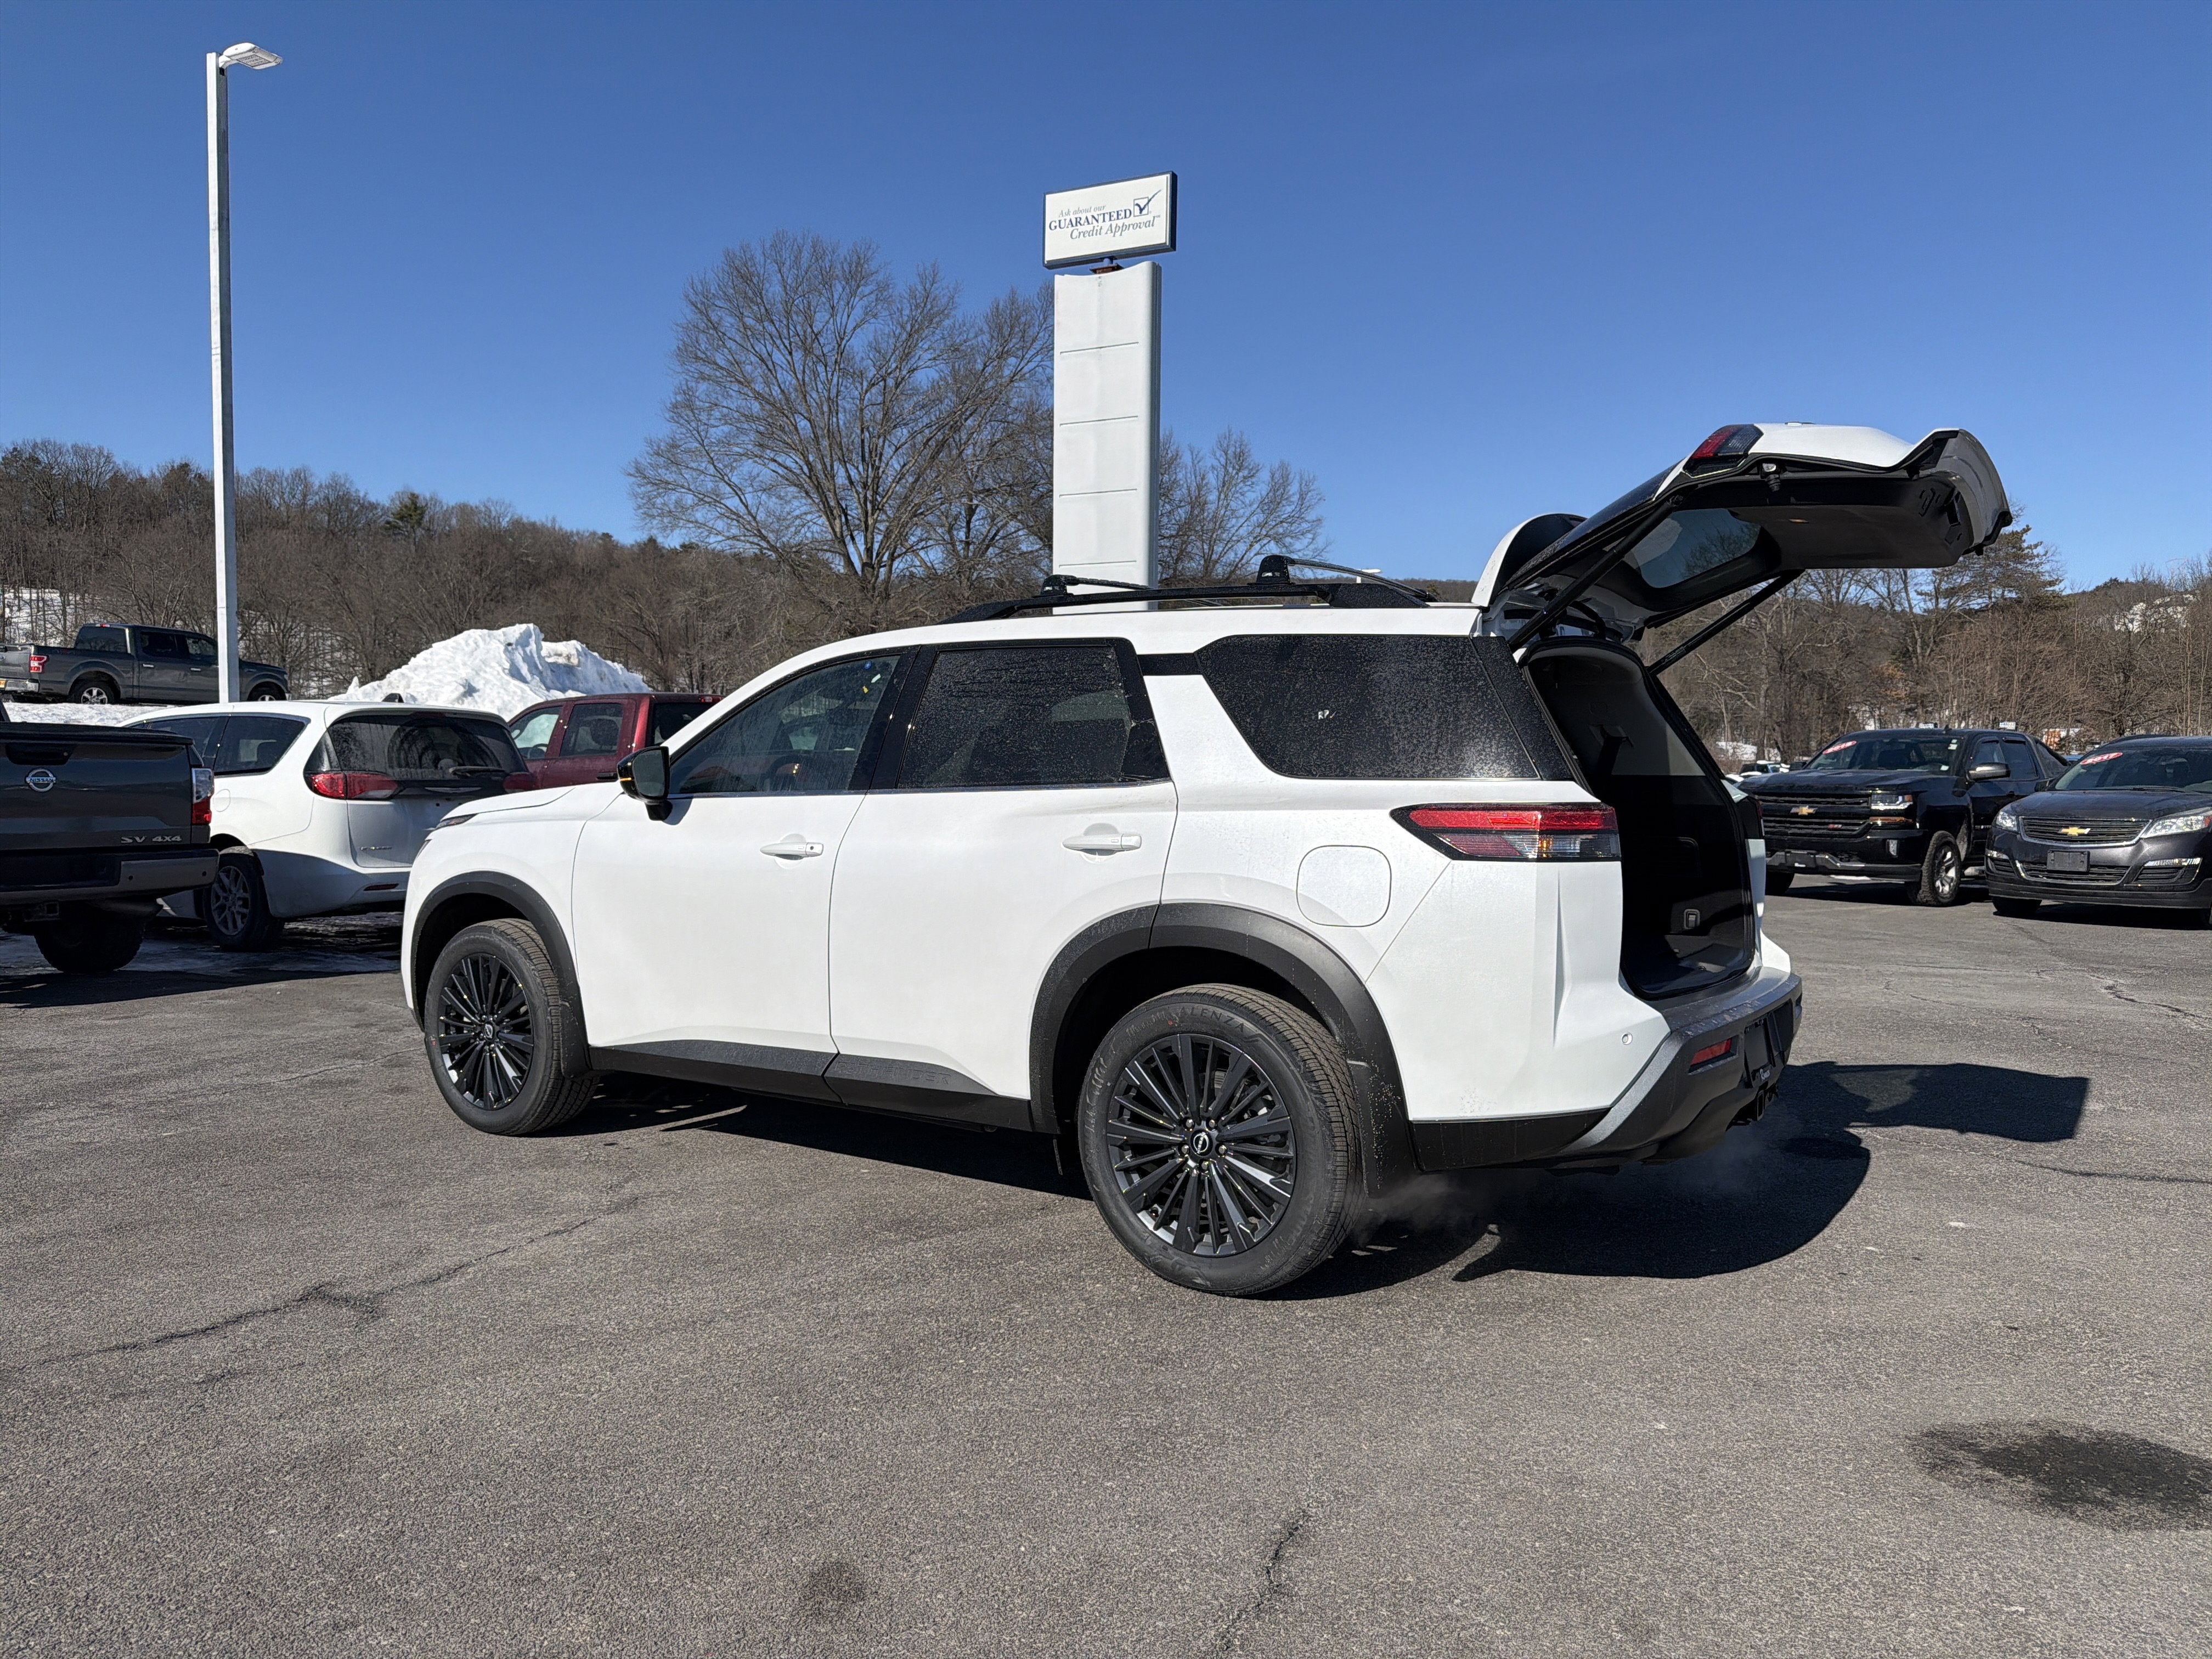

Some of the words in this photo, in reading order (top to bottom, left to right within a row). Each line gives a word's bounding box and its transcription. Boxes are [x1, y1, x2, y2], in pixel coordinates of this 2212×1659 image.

[1048, 208, 1132, 231] GUARANTEED
[1058, 208, 1071, 218] Ask
[1073, 206, 1092, 215] about
[1070, 224, 1103, 240] Credit
[1105, 216, 1156, 238] Approval
[1180, 1006, 1245, 1034] ALENZA
